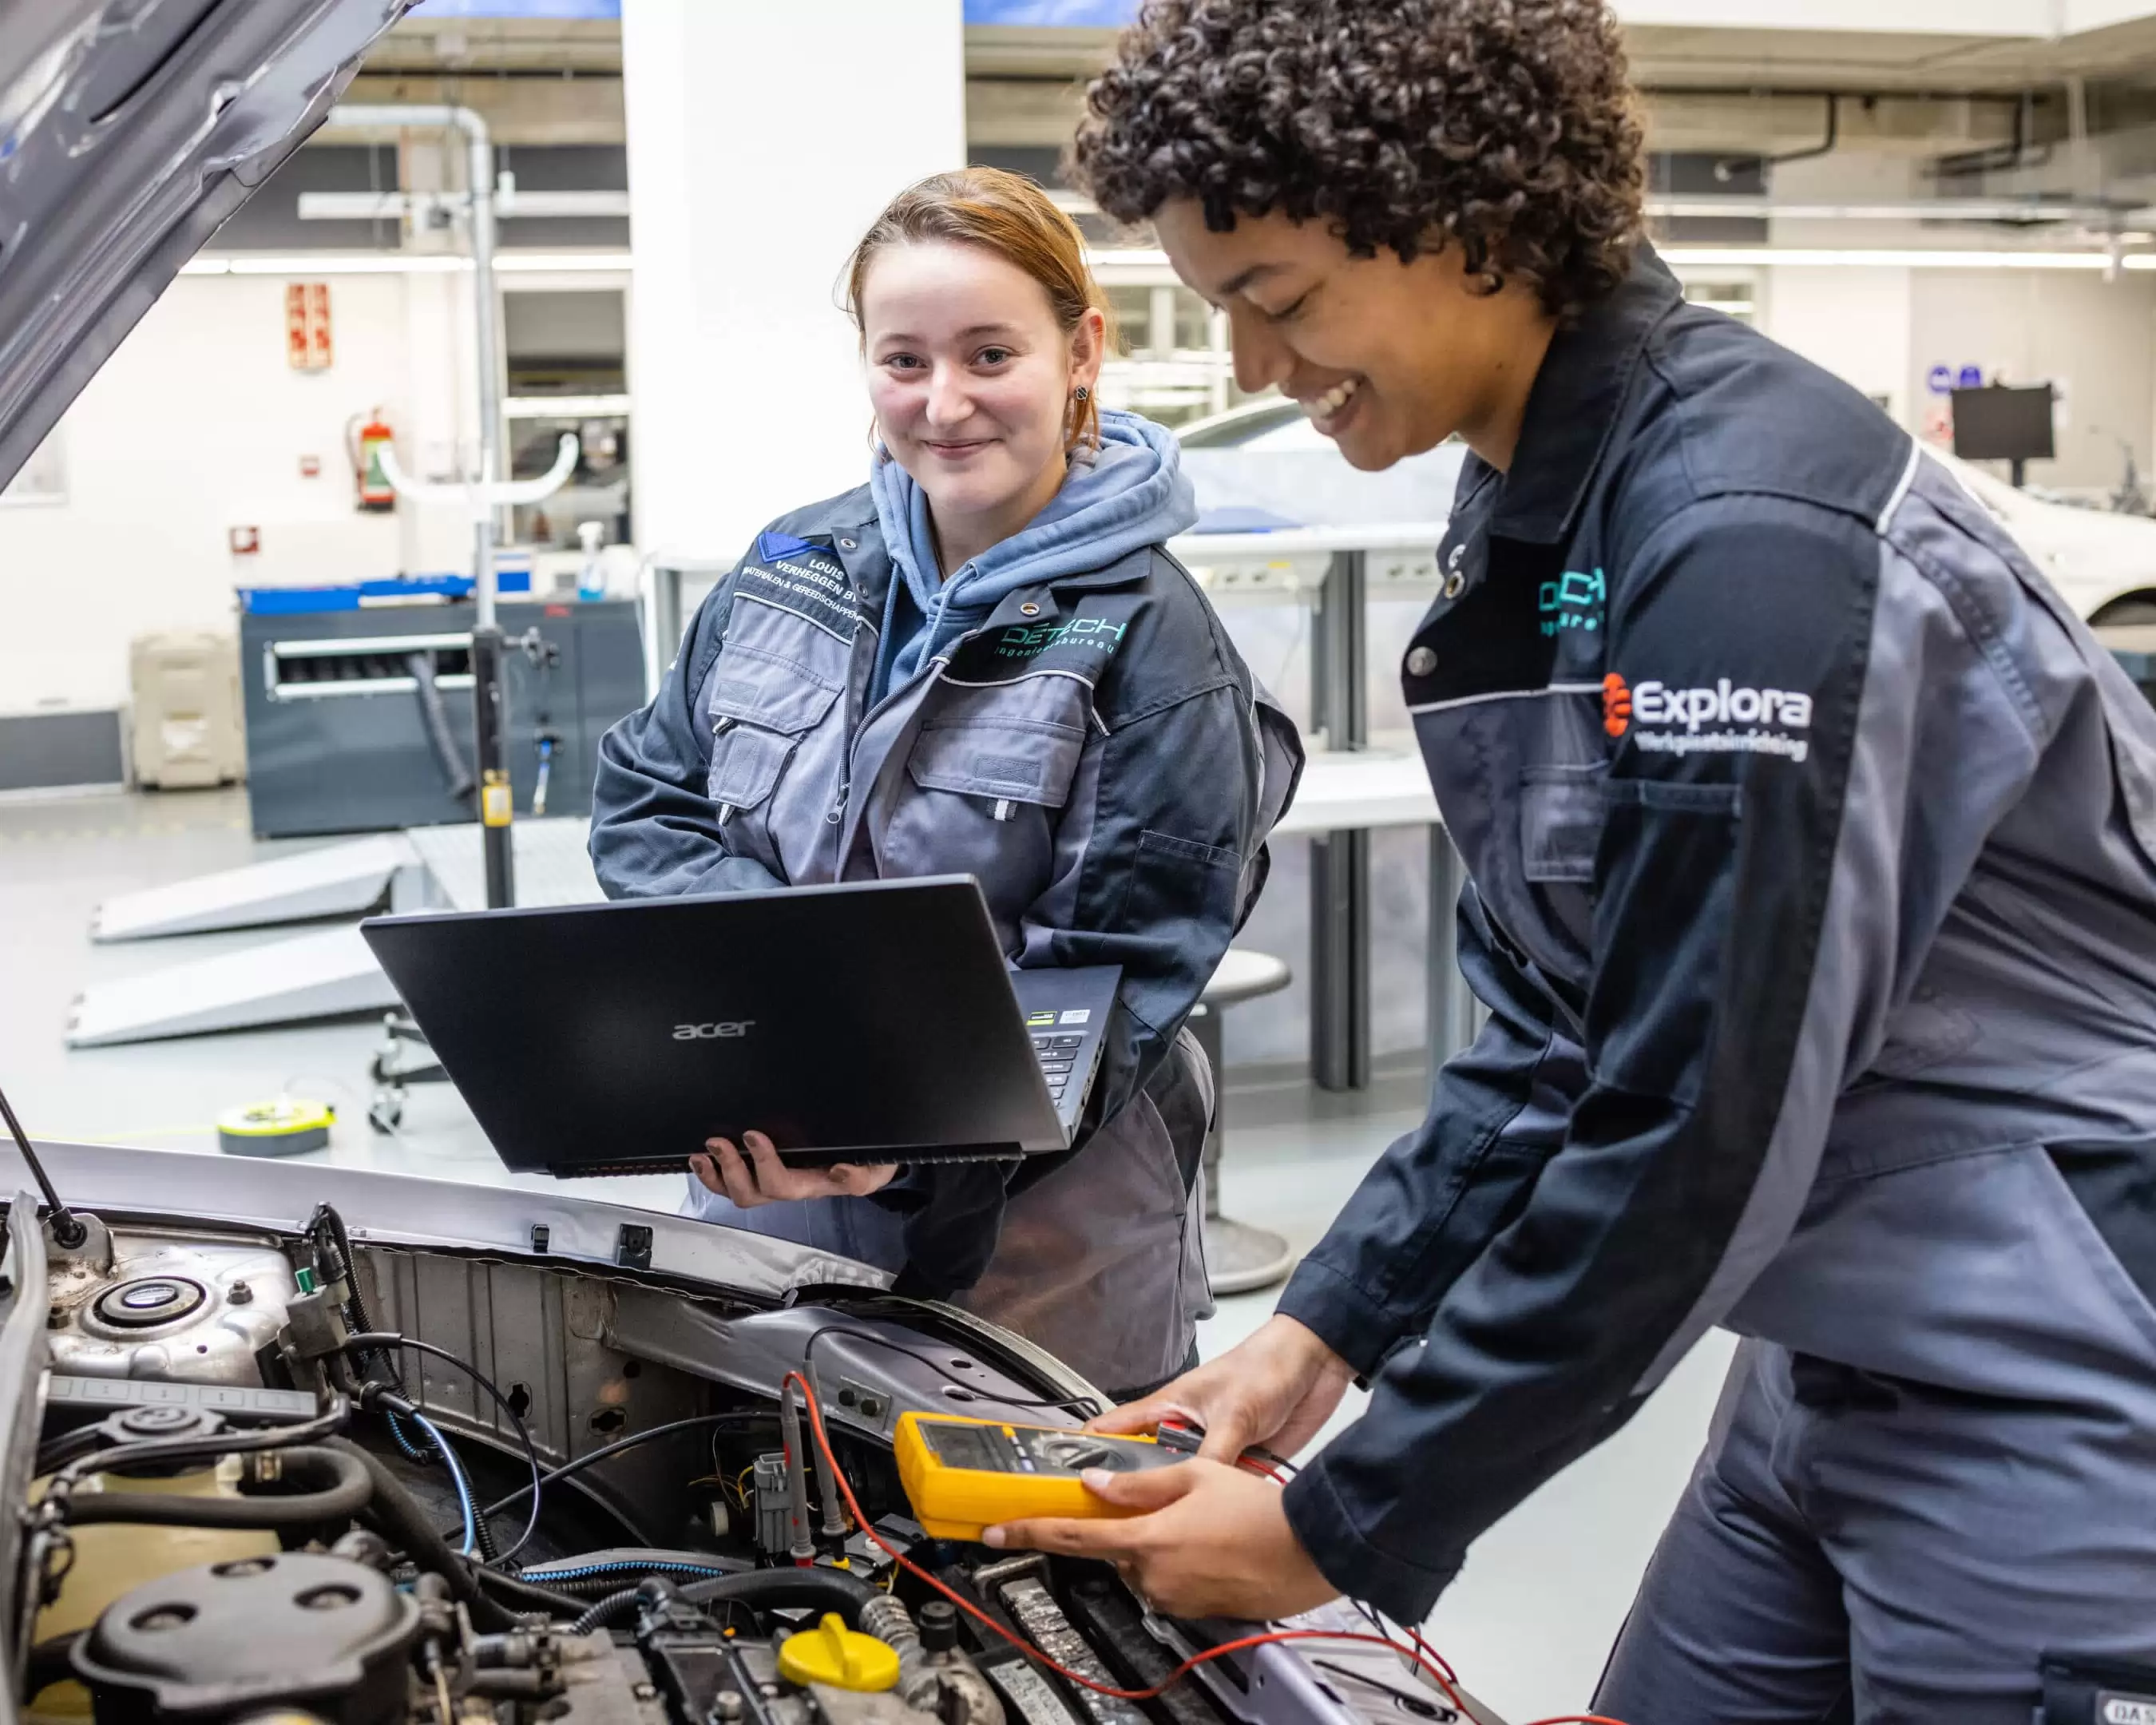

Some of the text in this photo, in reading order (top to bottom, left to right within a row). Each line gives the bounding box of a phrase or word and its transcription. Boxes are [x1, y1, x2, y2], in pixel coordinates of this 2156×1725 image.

[775, 560, 844, 597] VERHEGGEN
[809, 558, 845, 581] LOUIS
[1632, 677, 1813, 733] Explora
[672, 1020, 756, 1040] acer
